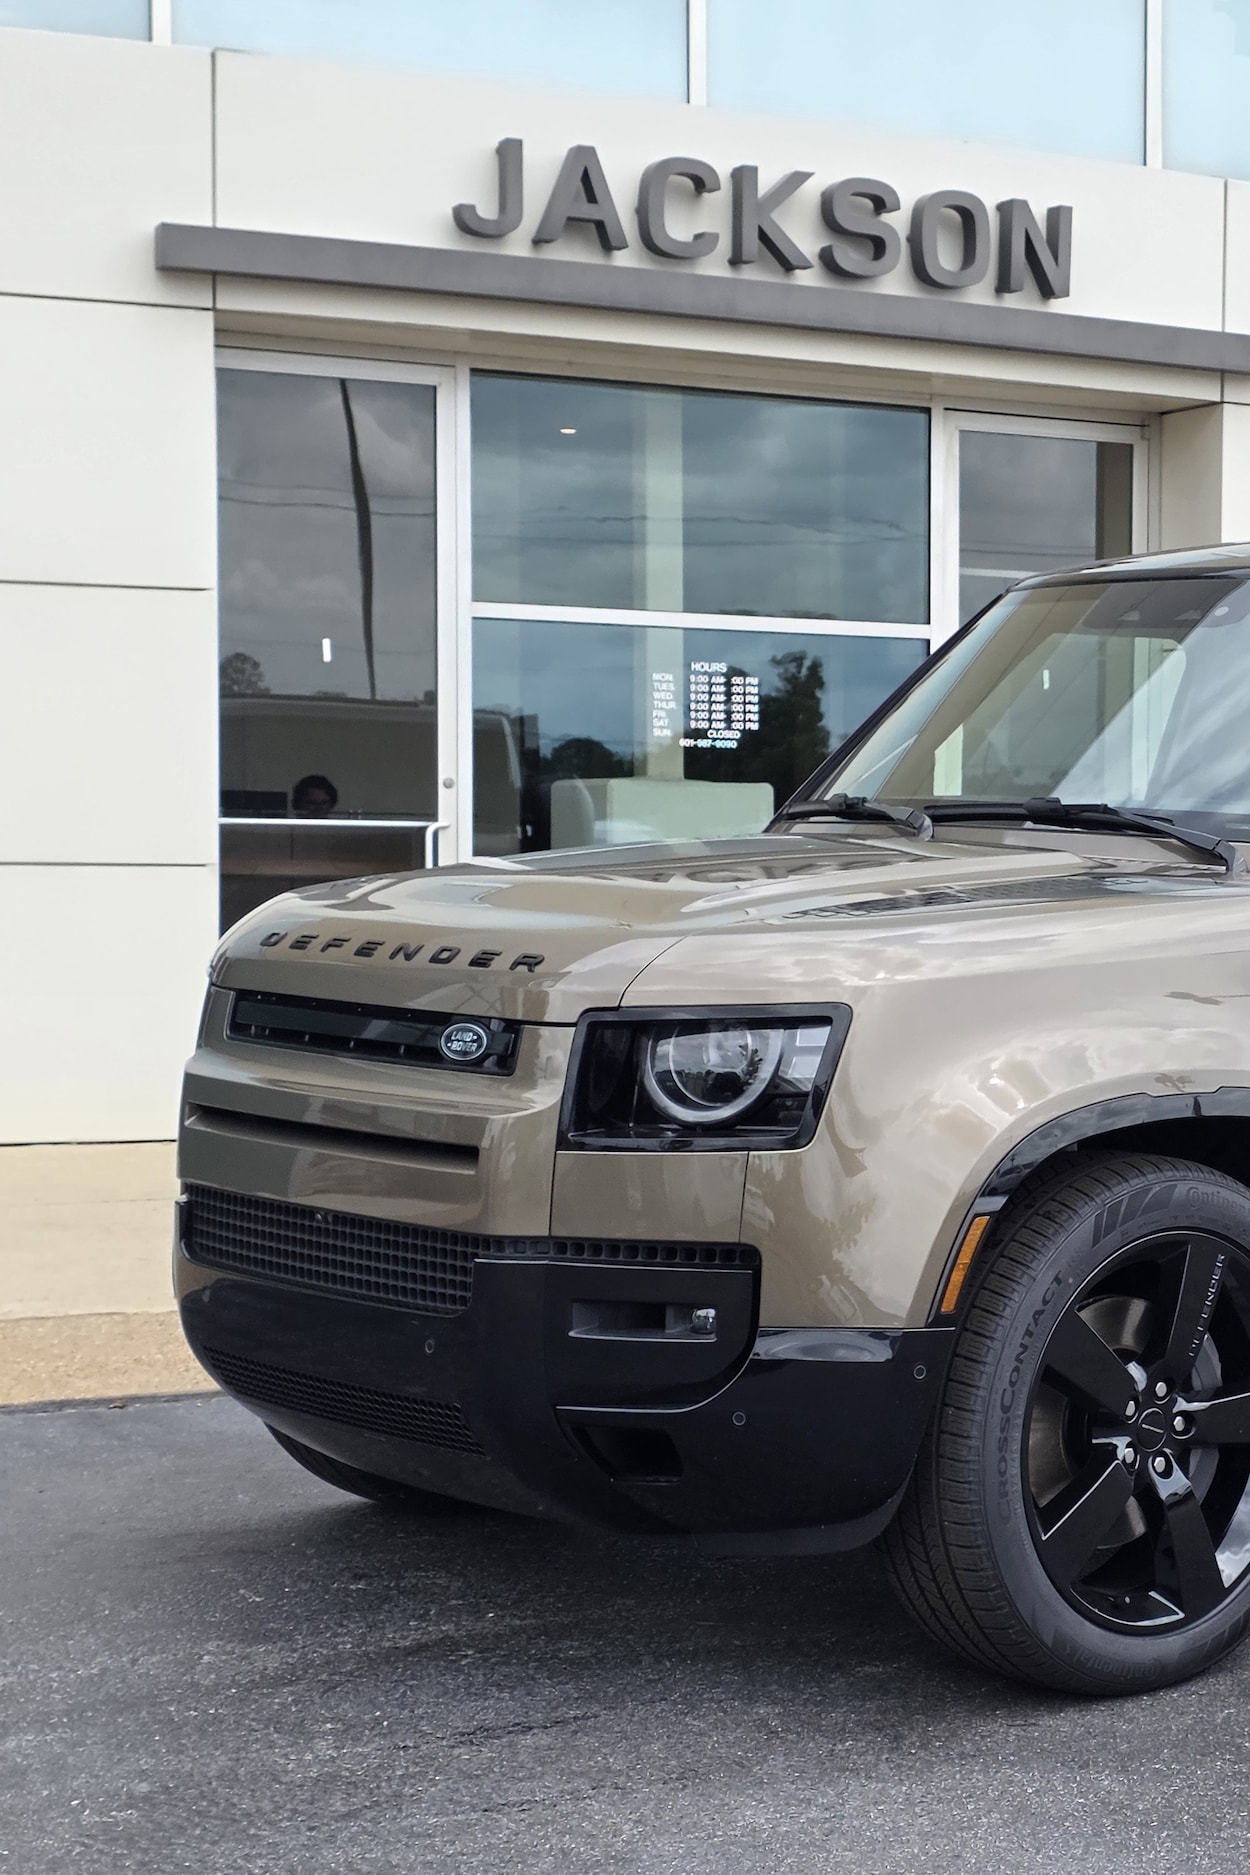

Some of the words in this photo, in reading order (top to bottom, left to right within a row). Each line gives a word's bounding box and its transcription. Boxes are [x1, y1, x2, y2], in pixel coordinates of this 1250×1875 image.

[453, 137, 1072, 299] JACKSON
[691, 661, 727, 672] HOURS
[745, 676, 759, 685] PM
[745, 686, 759, 694] PM
[745, 695, 759, 703] PM
[745, 704, 759, 712] PM
[745, 713, 759, 721] PM
[745, 722, 759, 730] PM
[707, 730, 741, 739] CLOSED
[259, 931, 545, 972] DEFENDER
